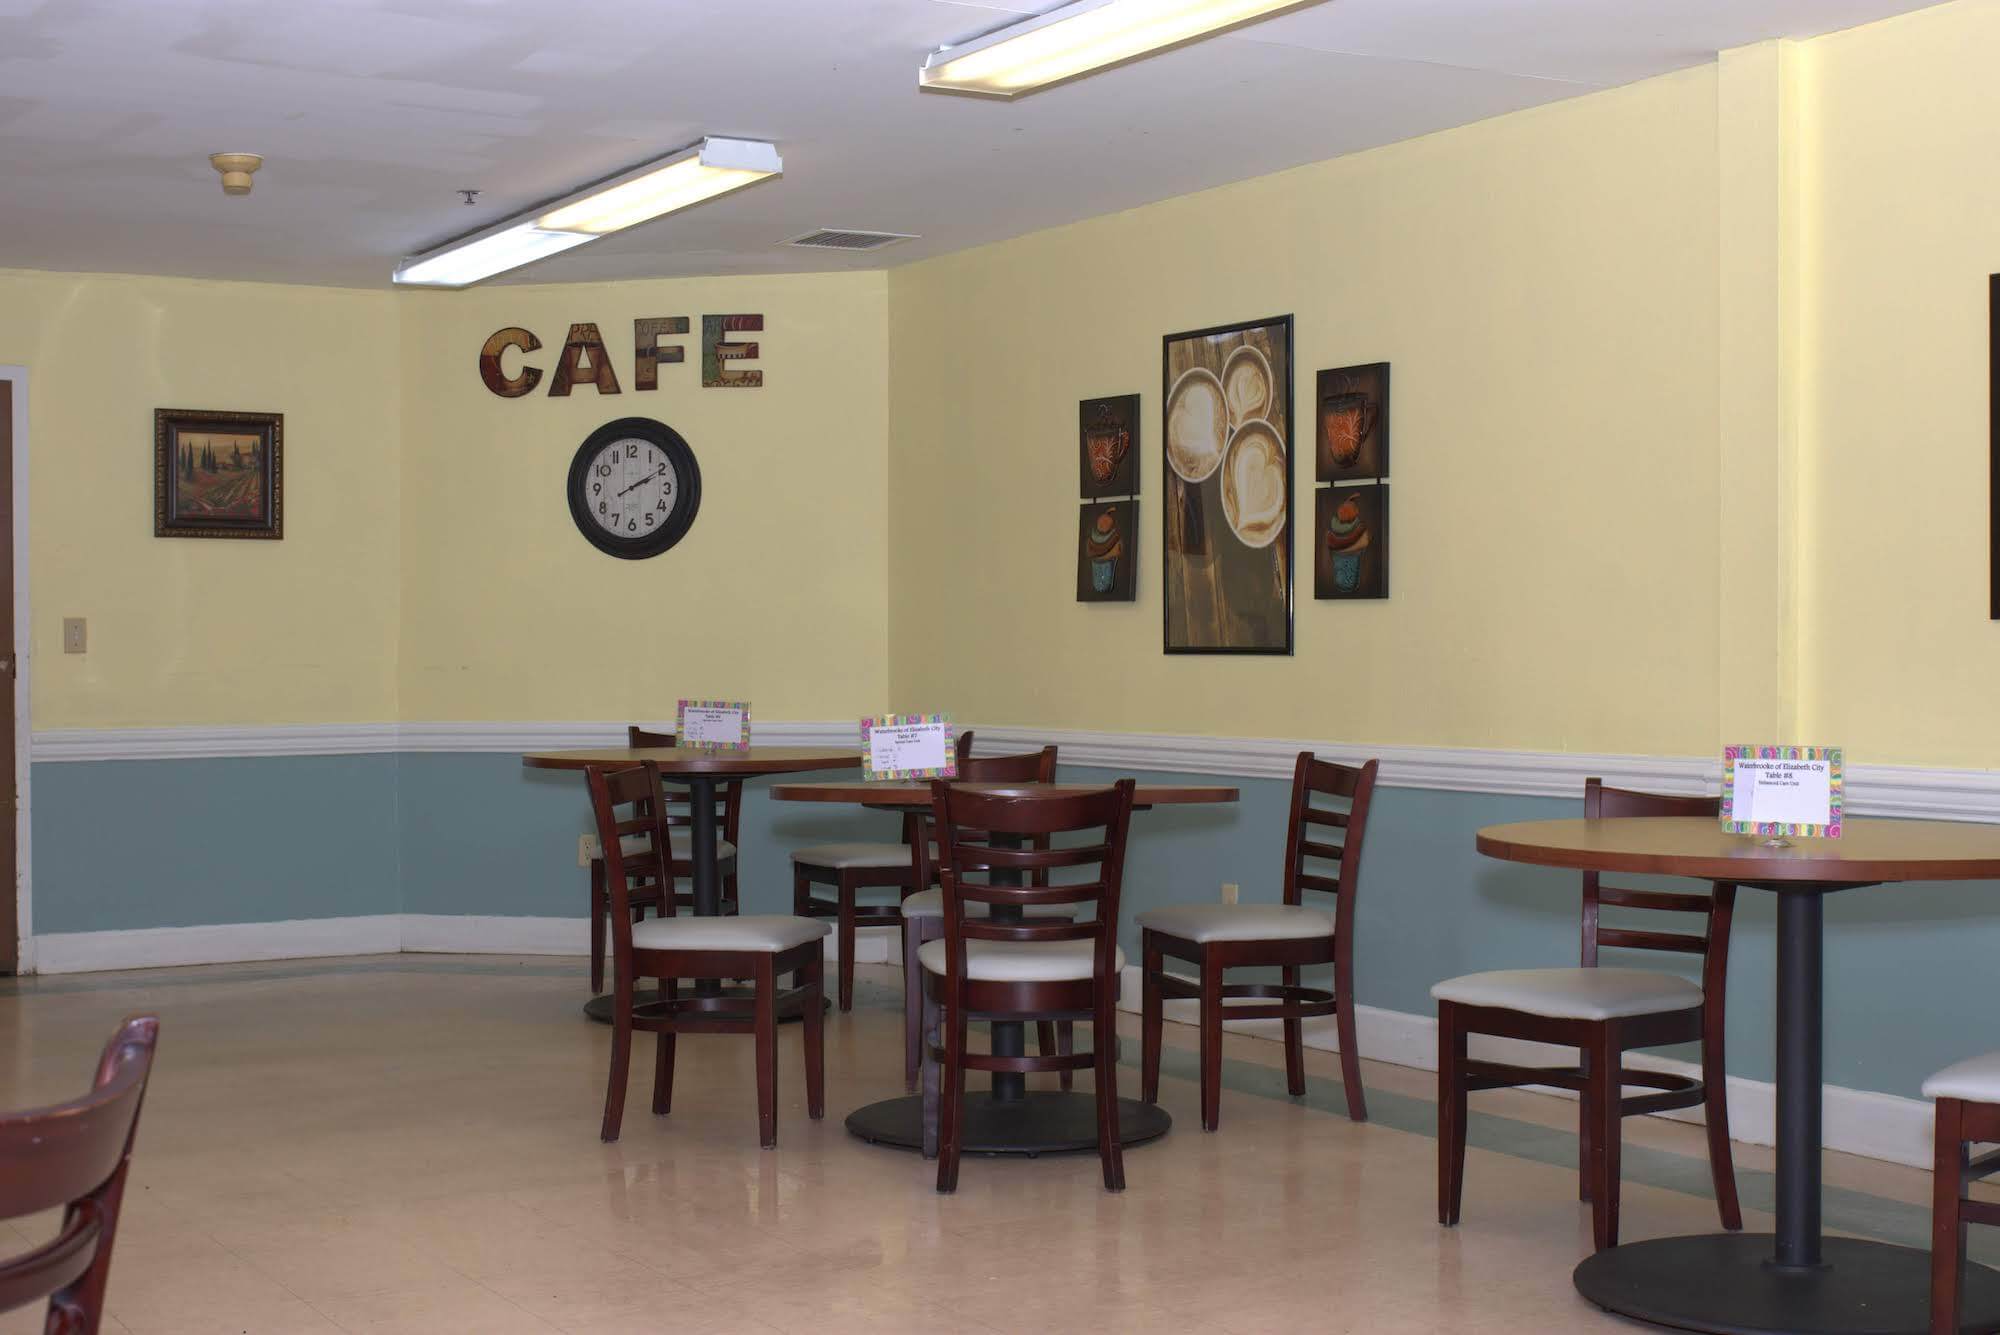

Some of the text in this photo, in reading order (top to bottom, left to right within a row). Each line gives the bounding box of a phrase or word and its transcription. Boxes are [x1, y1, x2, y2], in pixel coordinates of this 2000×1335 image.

[480, 314, 763, 398] CAFE
[612, 450, 619, 464] 11
[626, 444, 638, 458] 12
[596, 464, 611, 477] 10
[658, 462, 666, 476] 2
[593, 483, 601, 496] 9
[663, 482, 671, 495] 3
[599, 501, 606, 514] 8
[656, 499, 666, 512] 4
[611, 513, 620, 526] 7
[628, 518, 636, 531] 6
[645, 513, 654, 526] 5
[1782, 763, 1811, 771] Elizabeth
[1811, 764, 1824, 772] City
